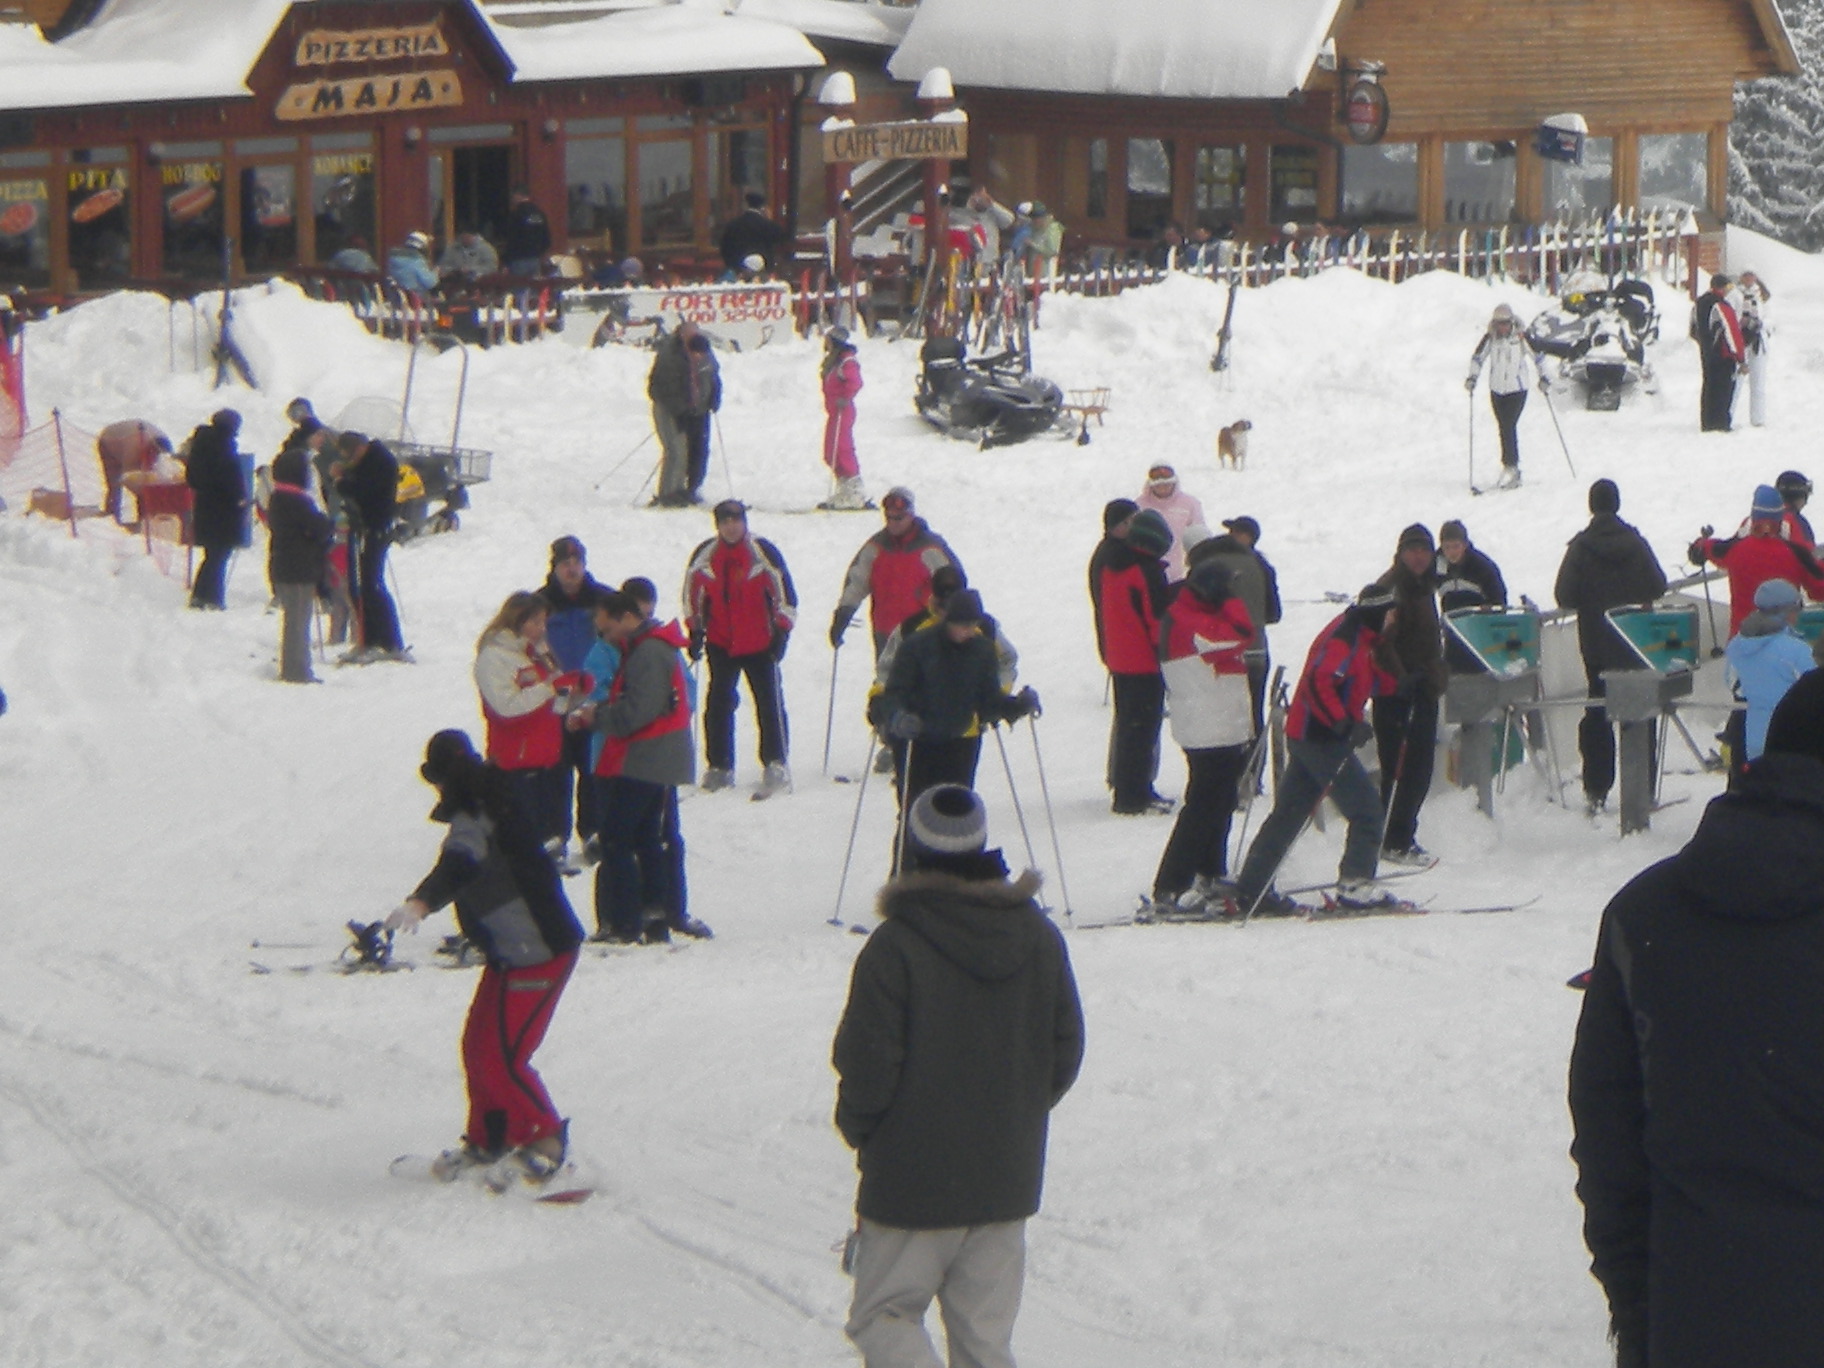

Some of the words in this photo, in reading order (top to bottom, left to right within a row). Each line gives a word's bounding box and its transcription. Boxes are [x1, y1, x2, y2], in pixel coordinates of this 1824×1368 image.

[306, 34, 439, 59] PIZZERIA
[312, 77, 433, 112] MAJA
[69, 169, 126, 190] PITA
[660, 294, 713, 311] FOR
